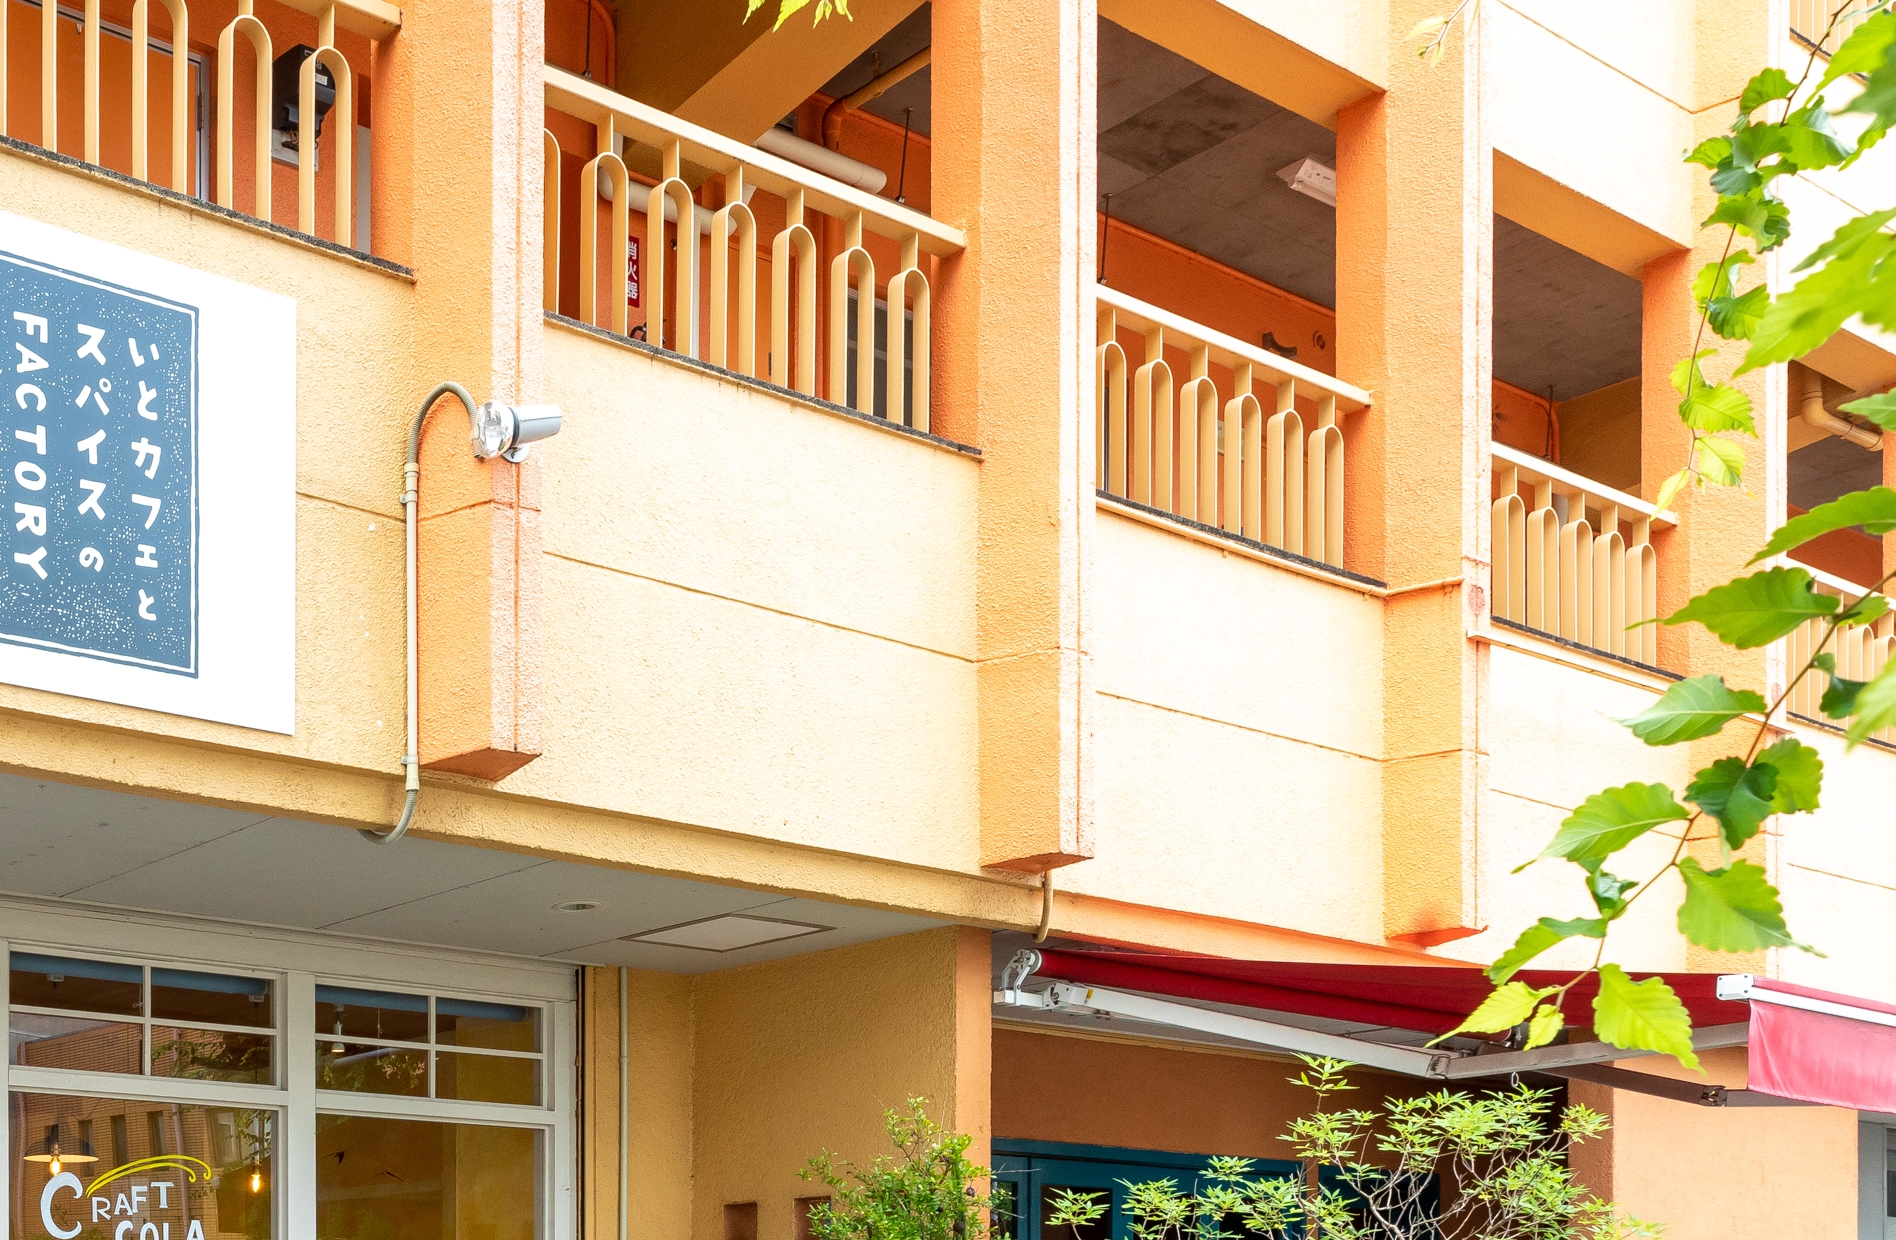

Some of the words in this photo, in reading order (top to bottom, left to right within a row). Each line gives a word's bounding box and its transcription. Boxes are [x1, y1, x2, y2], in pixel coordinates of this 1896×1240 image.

[13, 310, 49, 581] FACTORY
[75, 322, 113, 573] スパイスの
[128, 337, 161, 622] いとカフェと
[40, 1171, 175, 1240] CRAFT
